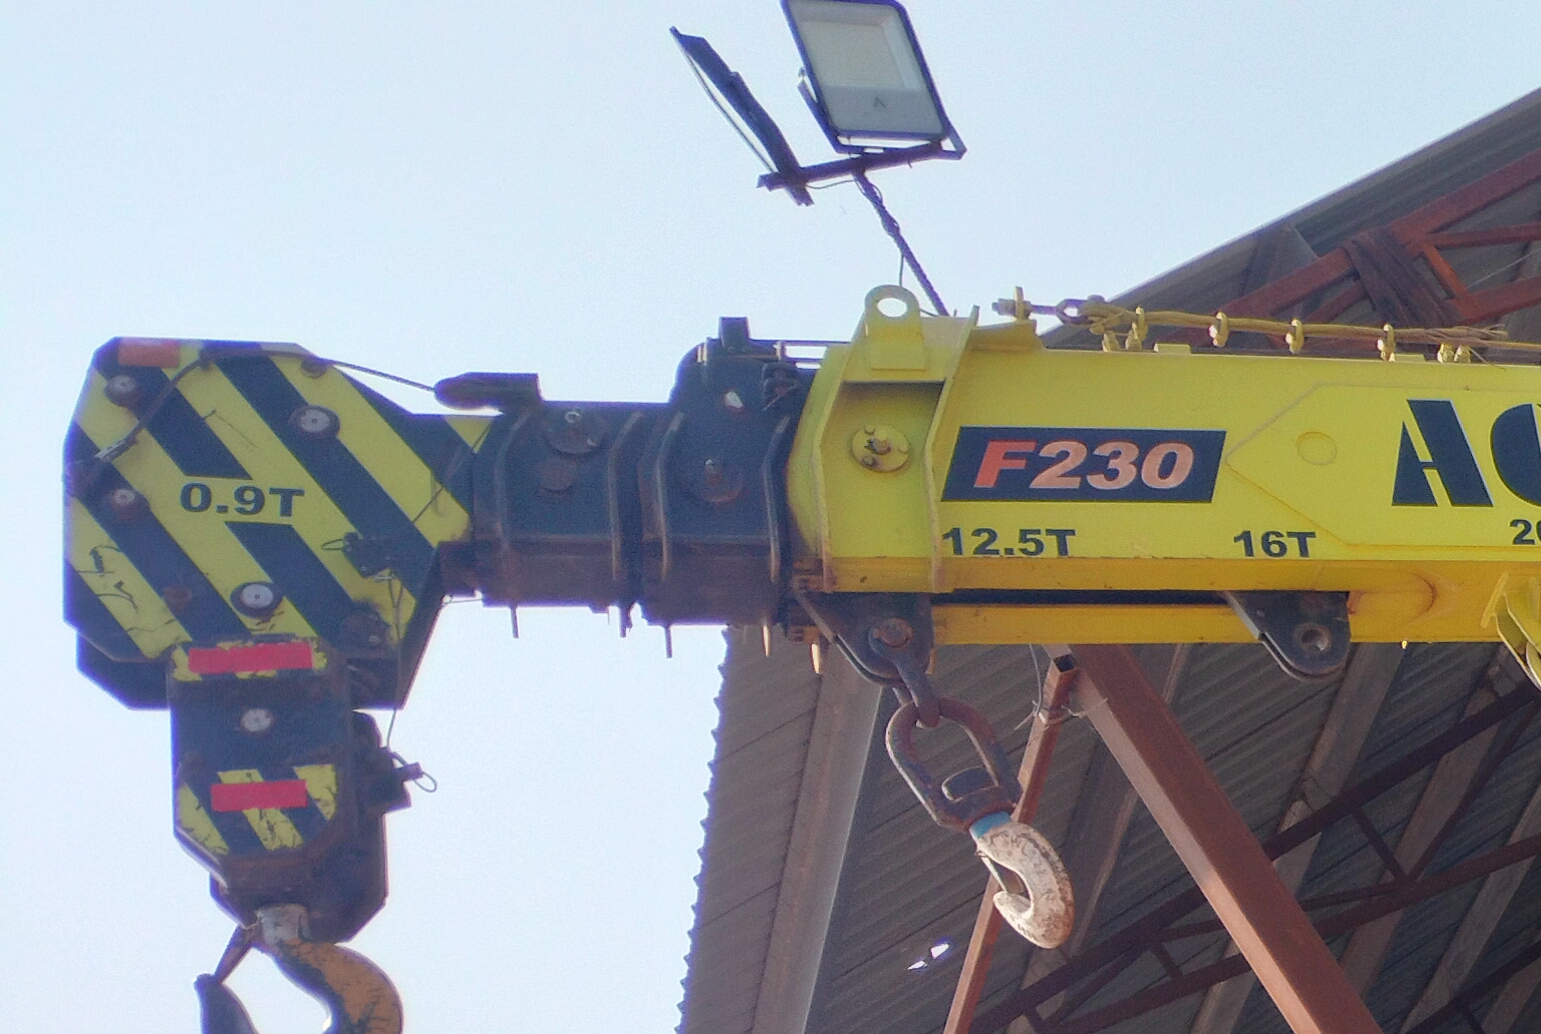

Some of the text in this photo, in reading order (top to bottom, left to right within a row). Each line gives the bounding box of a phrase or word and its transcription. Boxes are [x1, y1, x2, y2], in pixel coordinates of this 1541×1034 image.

[973, 438, 1194, 490] F230
[180, 482, 305, 518] 0.9T
[942, 527, 1076, 557] 12.5T
[1233, 530, 1317, 558] 16T
